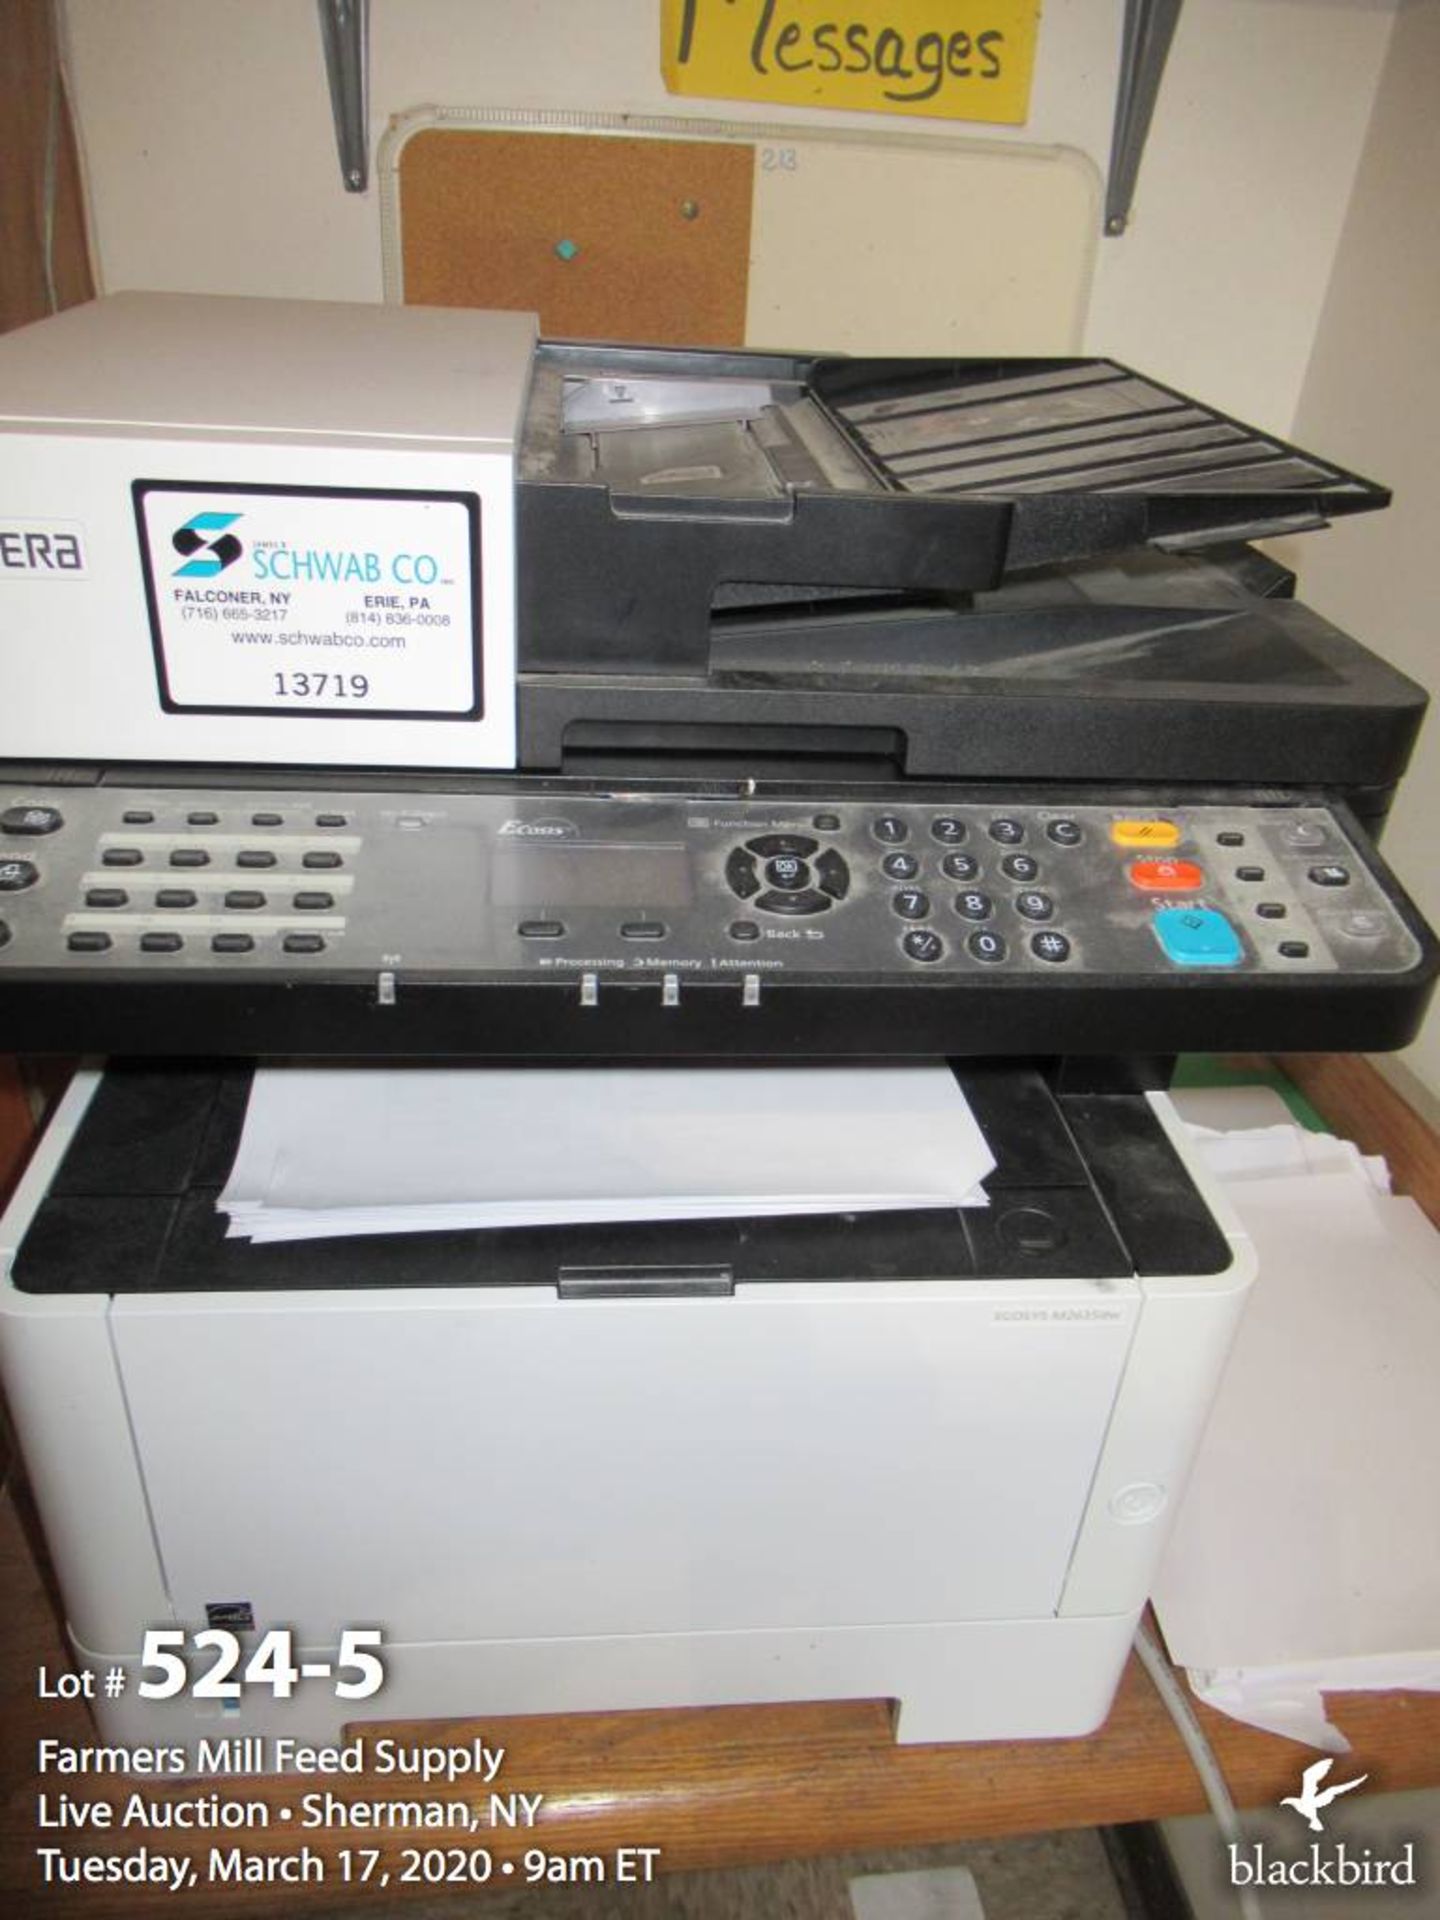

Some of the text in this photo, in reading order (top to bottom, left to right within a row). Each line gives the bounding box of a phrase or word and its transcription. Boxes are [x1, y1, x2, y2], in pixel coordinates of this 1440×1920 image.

[677, 0, 1004, 101] Messages
[253, 549, 381, 583] SCHWAB
[392, 554, 438, 585] CO
[174, 589, 291, 606] FALCONER, NY
[364, 595, 431, 611] ERIE, PA
[181, 606, 218, 621] (716)
[345, 611, 382, 625] (814)
[231, 630, 406, 649] www.schwabco.com
[275, 672, 369, 698] 13719
[884, 821, 896, 835] 1
[941, 822, 958, 835] 2
[999, 822, 1015, 836] 3
[1056, 824, 1075, 837] C
[893, 858, 908, 871] 4
[954, 858, 970, 872] 5
[1013, 858, 1029, 872] 6
[903, 895, 918, 909] 7
[965, 896, 983, 910] 8
[1026, 896, 1043, 910] 9
[766, 929, 800, 939] Back
[979, 936, 996, 951] 0
[1040, 936, 1064, 953] #
[555, 957, 625, 969] Processing
[647, 957, 702, 969] Memory
[720, 958, 784, 969] Attention
